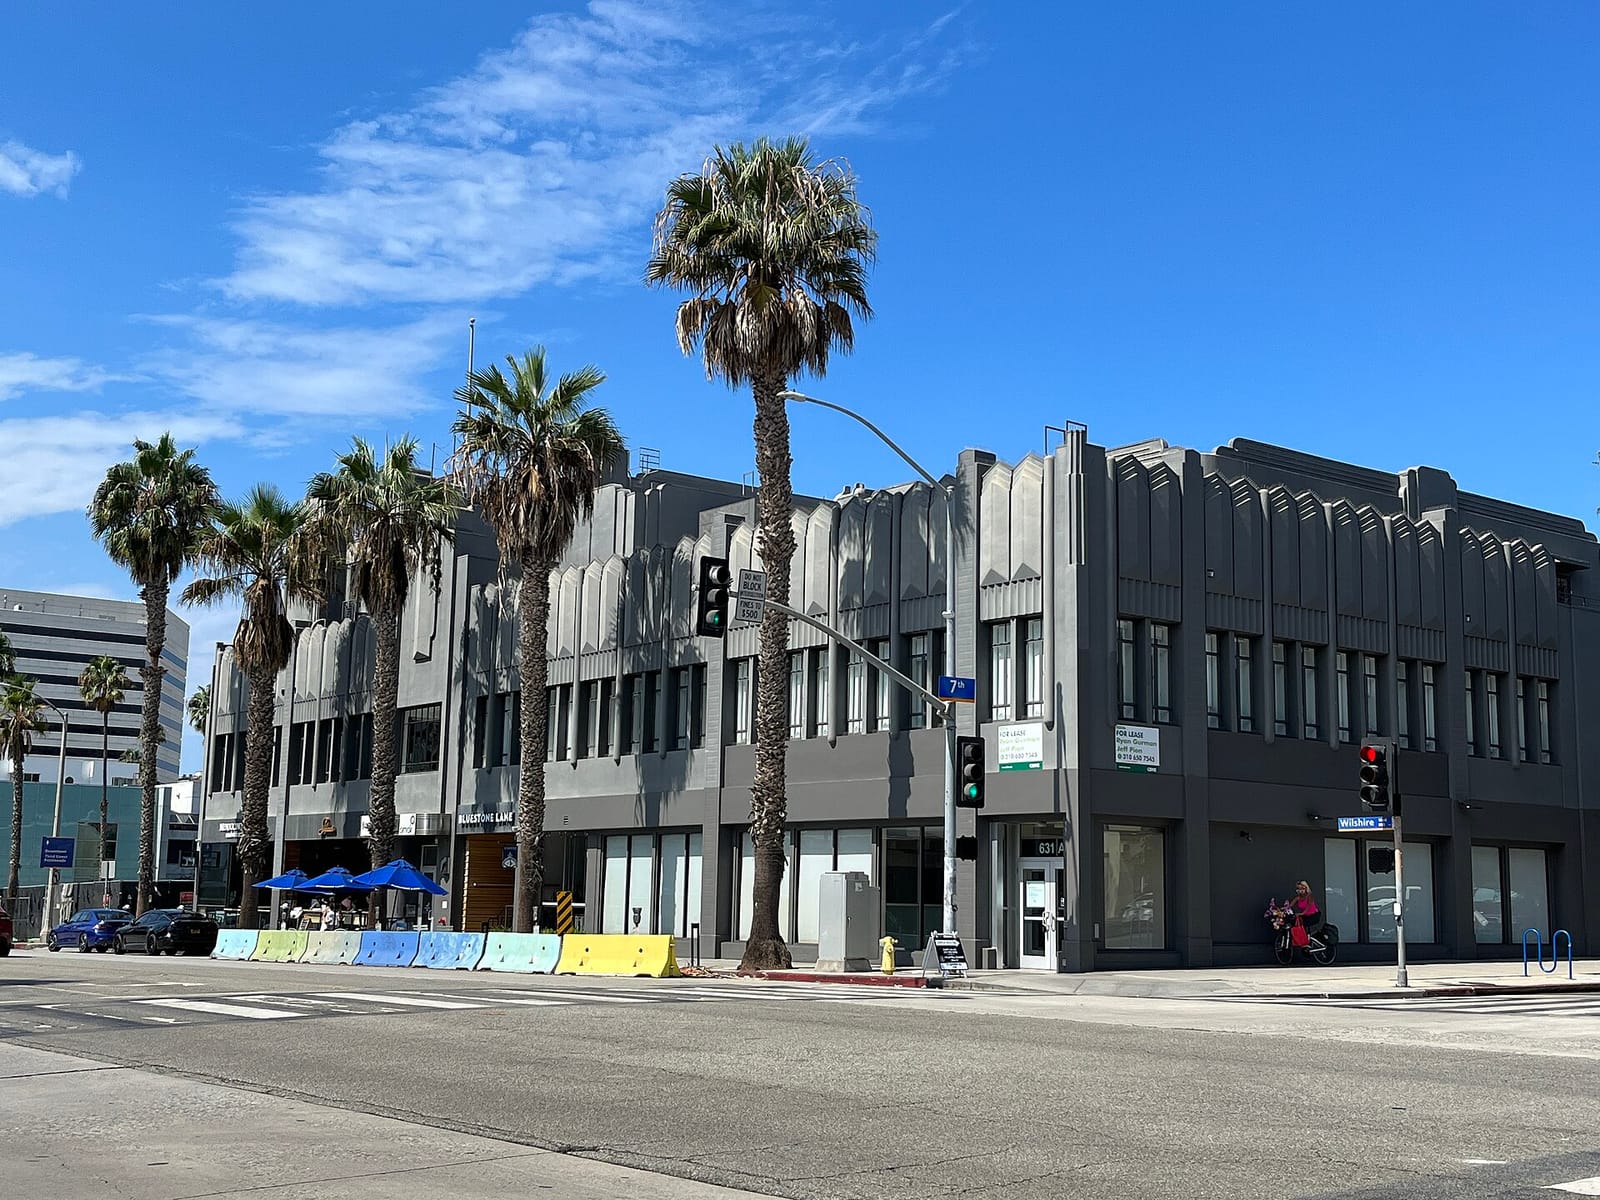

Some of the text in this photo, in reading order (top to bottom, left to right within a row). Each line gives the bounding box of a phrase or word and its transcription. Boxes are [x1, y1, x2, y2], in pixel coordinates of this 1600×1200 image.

[743, 581, 762, 591] BLOCK
[742, 609, 758, 619] $500
[950, 679, 965, 694] 7th
[1128, 731, 1144, 739] LEASE
[458, 811, 513, 824] BLUESTONE LANE
[1340, 818, 1375, 828] Wilshire
[1039, 842, 1054, 854] 631
